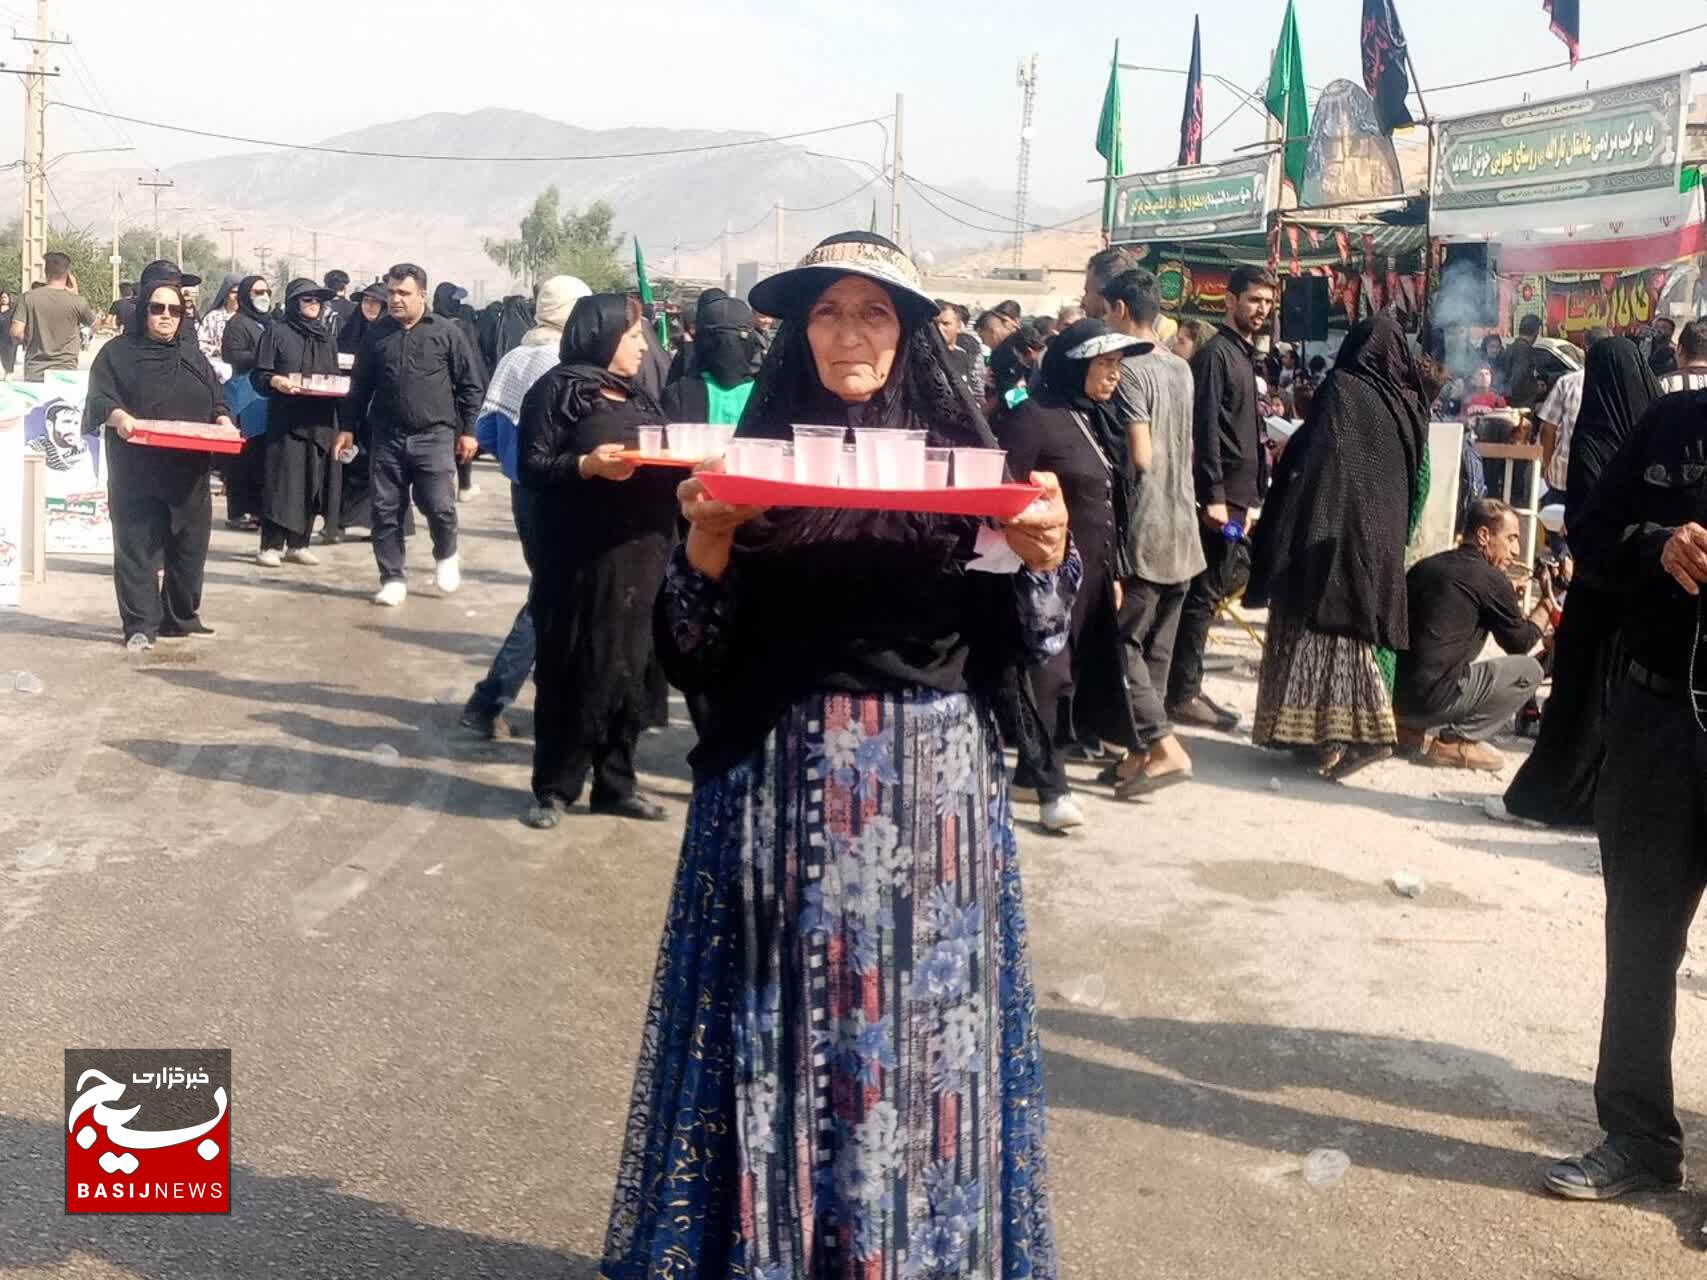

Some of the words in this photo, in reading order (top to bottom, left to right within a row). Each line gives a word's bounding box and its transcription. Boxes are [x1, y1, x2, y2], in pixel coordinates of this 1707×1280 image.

[1618, 120, 1644, 156] موکب
[1644, 123, 1655, 151] به
[1452, 144, 1473, 177] آمدید
[1472, 144, 1491, 177] خوش
